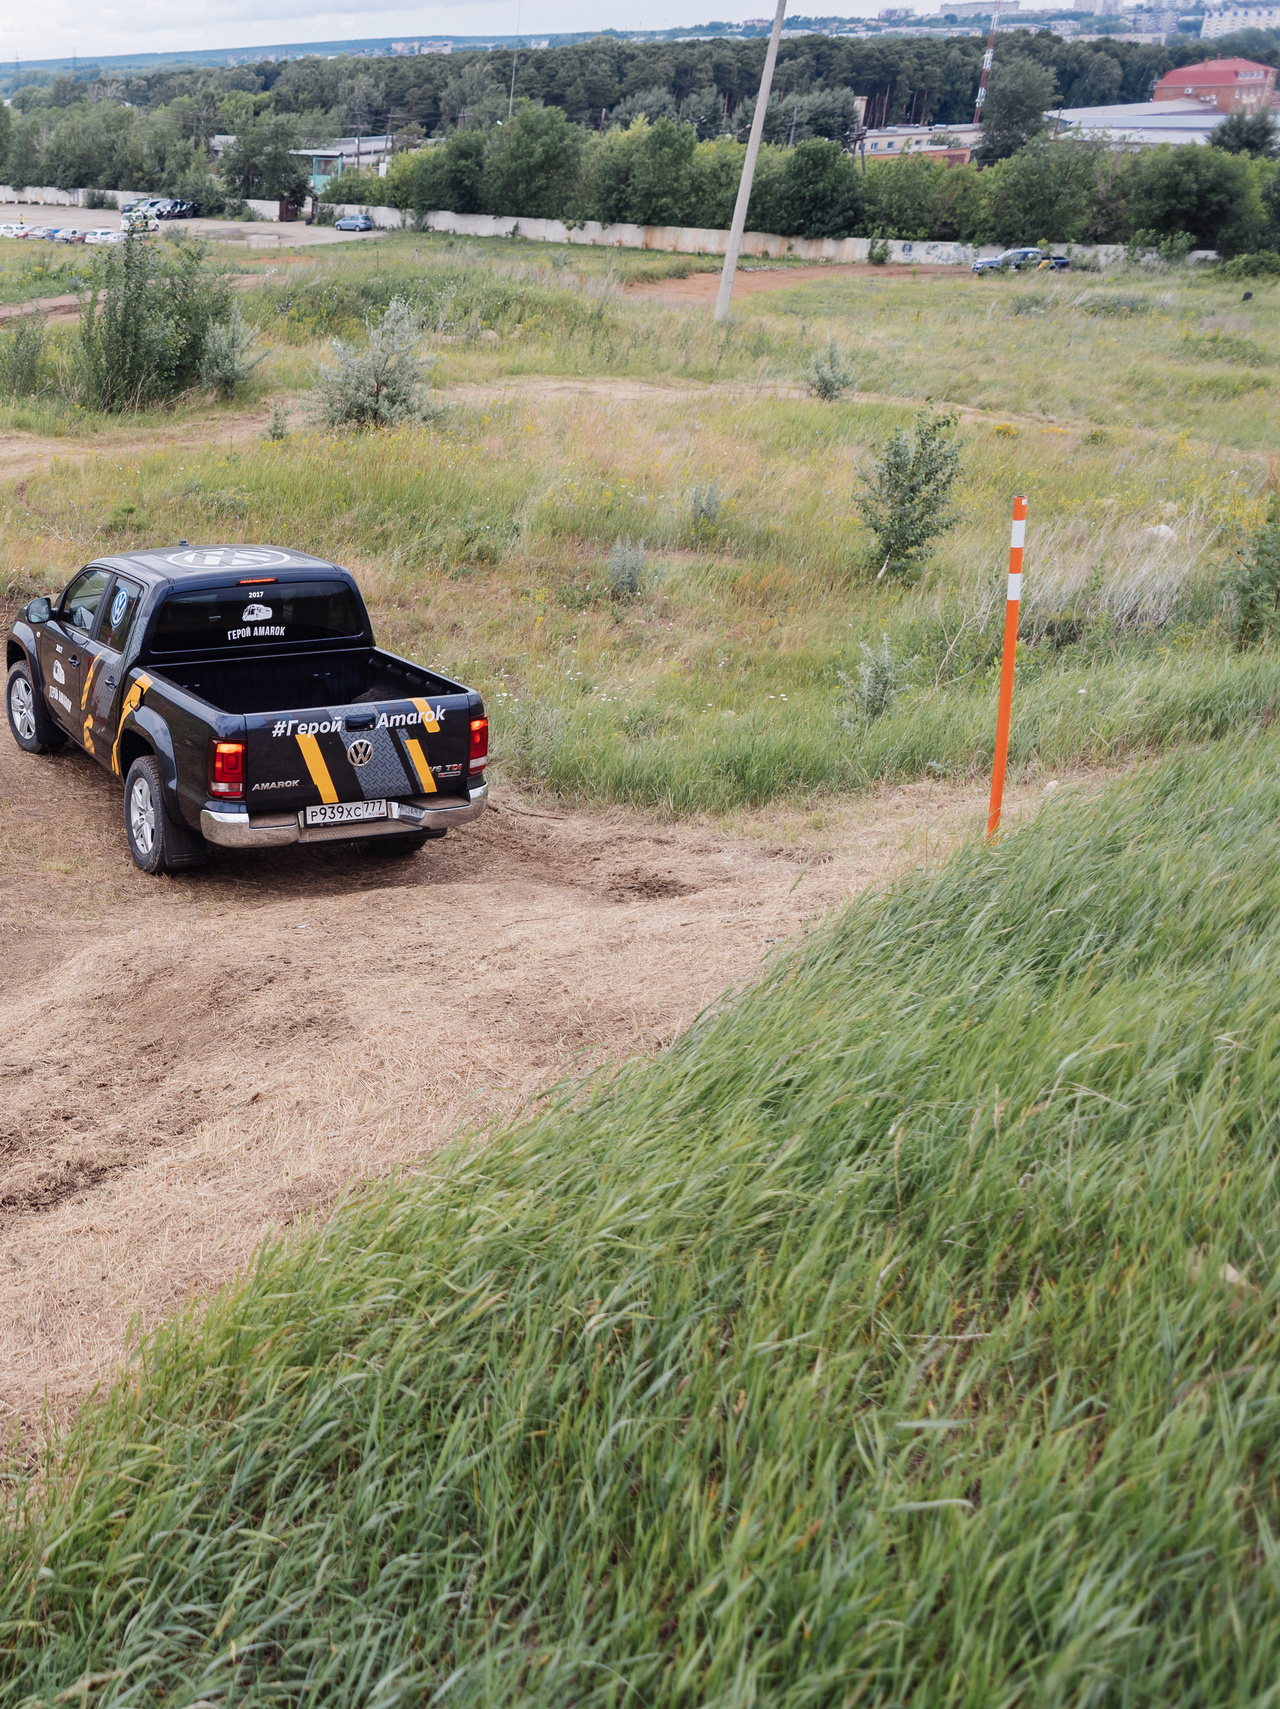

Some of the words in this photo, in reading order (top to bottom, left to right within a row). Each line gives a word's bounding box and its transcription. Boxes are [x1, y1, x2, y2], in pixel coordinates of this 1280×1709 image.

[227, 626, 251, 640] ГЕРОЙ
[253, 626, 286, 637] AMAROK
[272, 715, 343, 738] #Герой
[375, 704, 446, 729] Amarok
[445, 763, 463, 771] TDI
[251, 779, 300, 791] AMAROK
